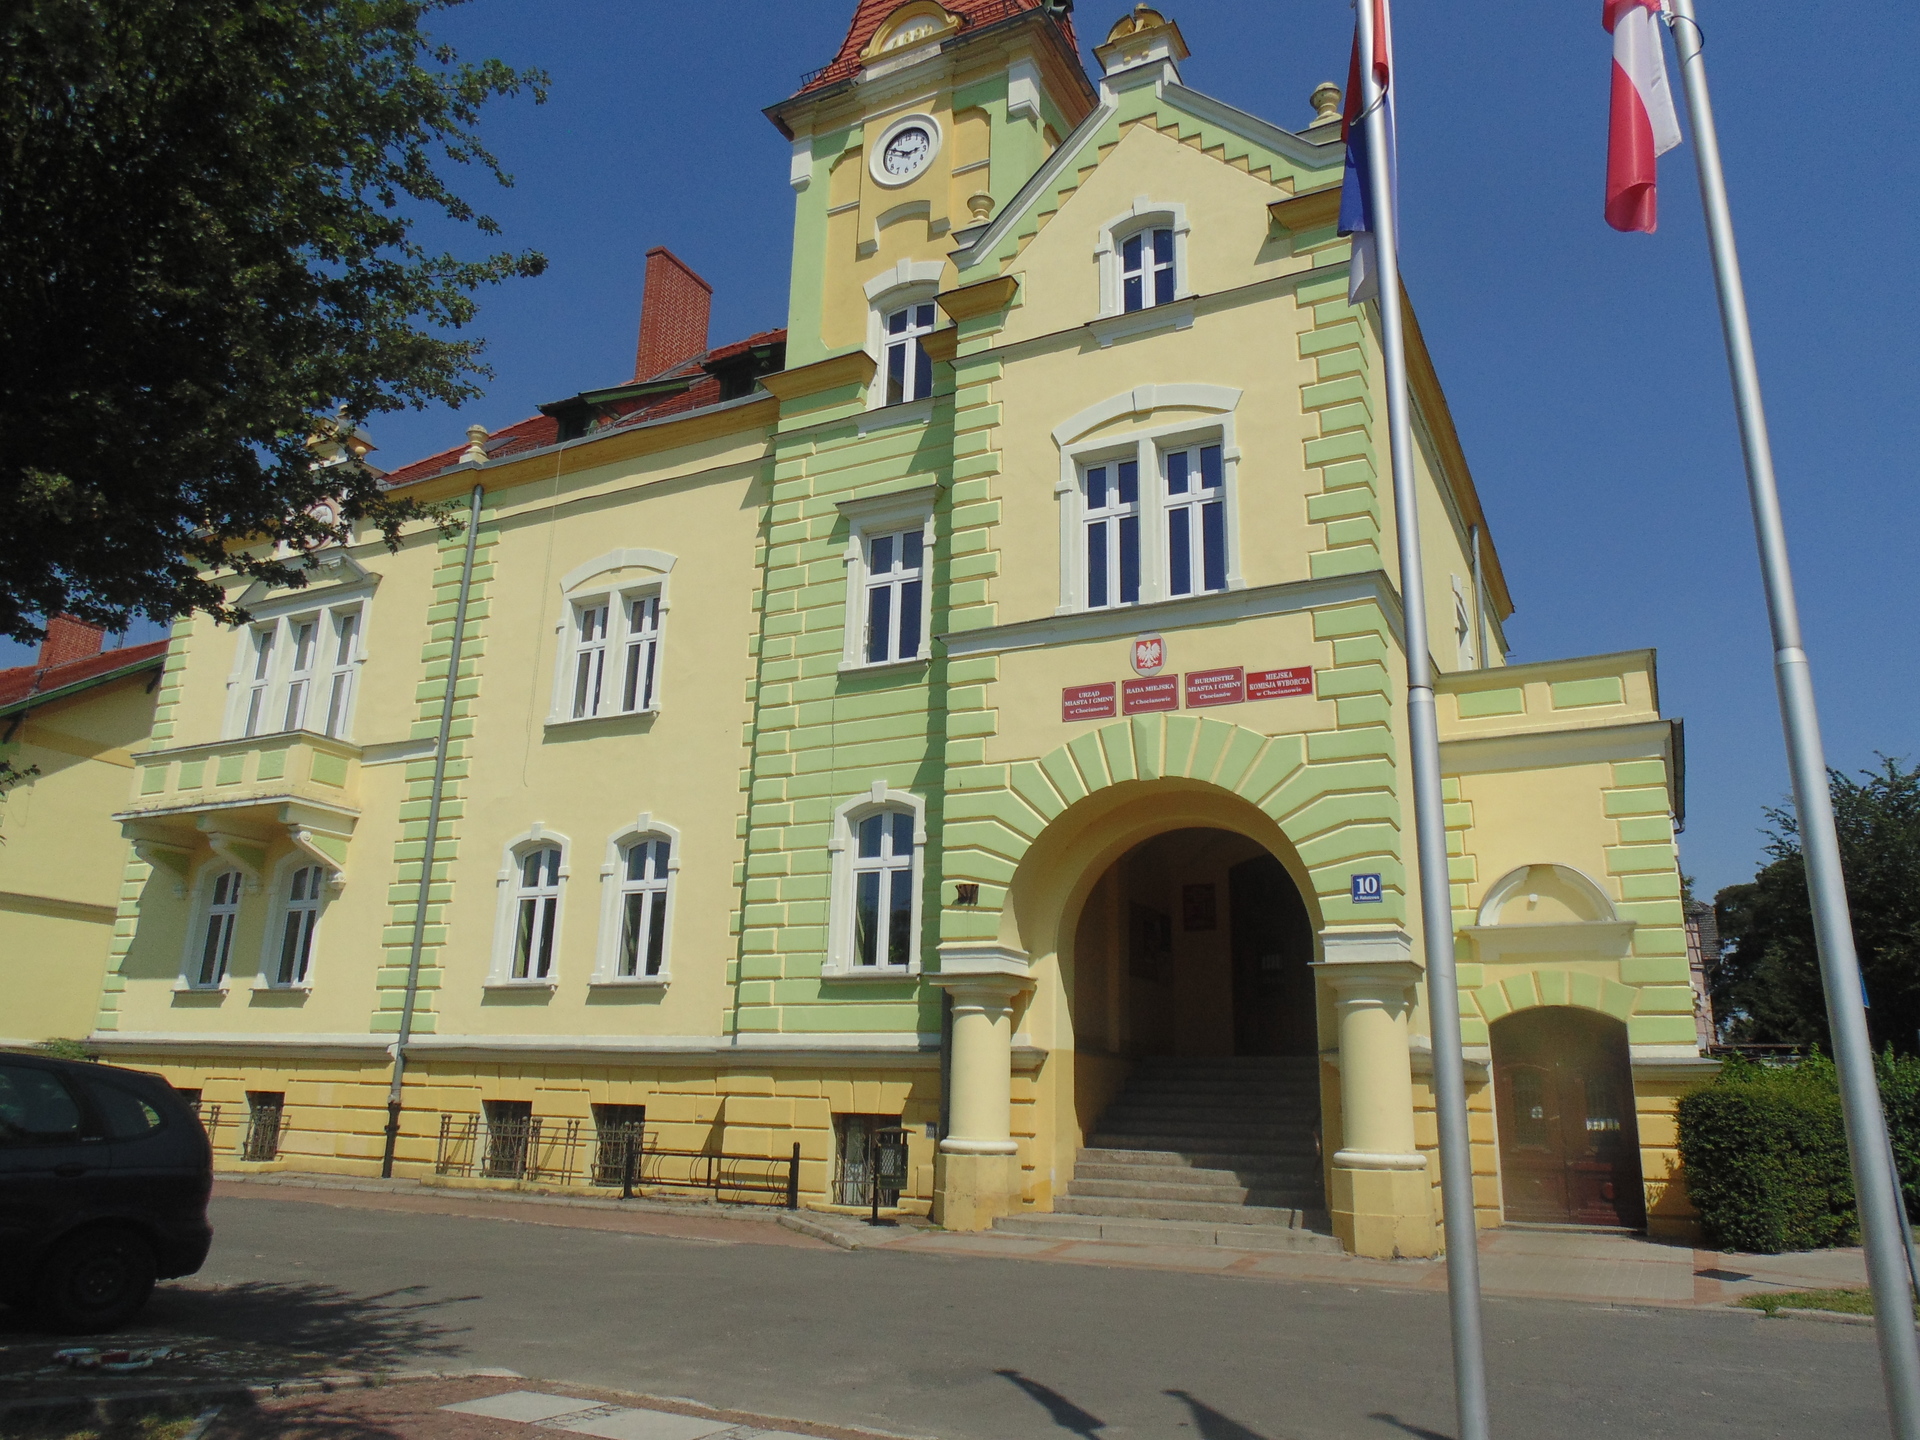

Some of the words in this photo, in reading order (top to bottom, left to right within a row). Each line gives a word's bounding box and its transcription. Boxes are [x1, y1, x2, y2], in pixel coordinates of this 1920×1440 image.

[1194, 674, 1234, 684] BURMISTRZ
[1265, 671, 1293, 681] MIEJSKA
[1145, 684, 1174, 692] MIEJSKA
[1218, 681, 1242, 689] GMINY
[1249, 680, 1276, 691] KOMISJA
[1276, 677, 1310, 687] WYBORCZA
[1078, 690, 1100, 698] URZĄD
[1262, 687, 1302, 696] Chocianowie
[1092, 696, 1114, 704] GMINY
[1136, 696, 1171, 705] Chocianowie
[1356, 876, 1378, 894] 10
